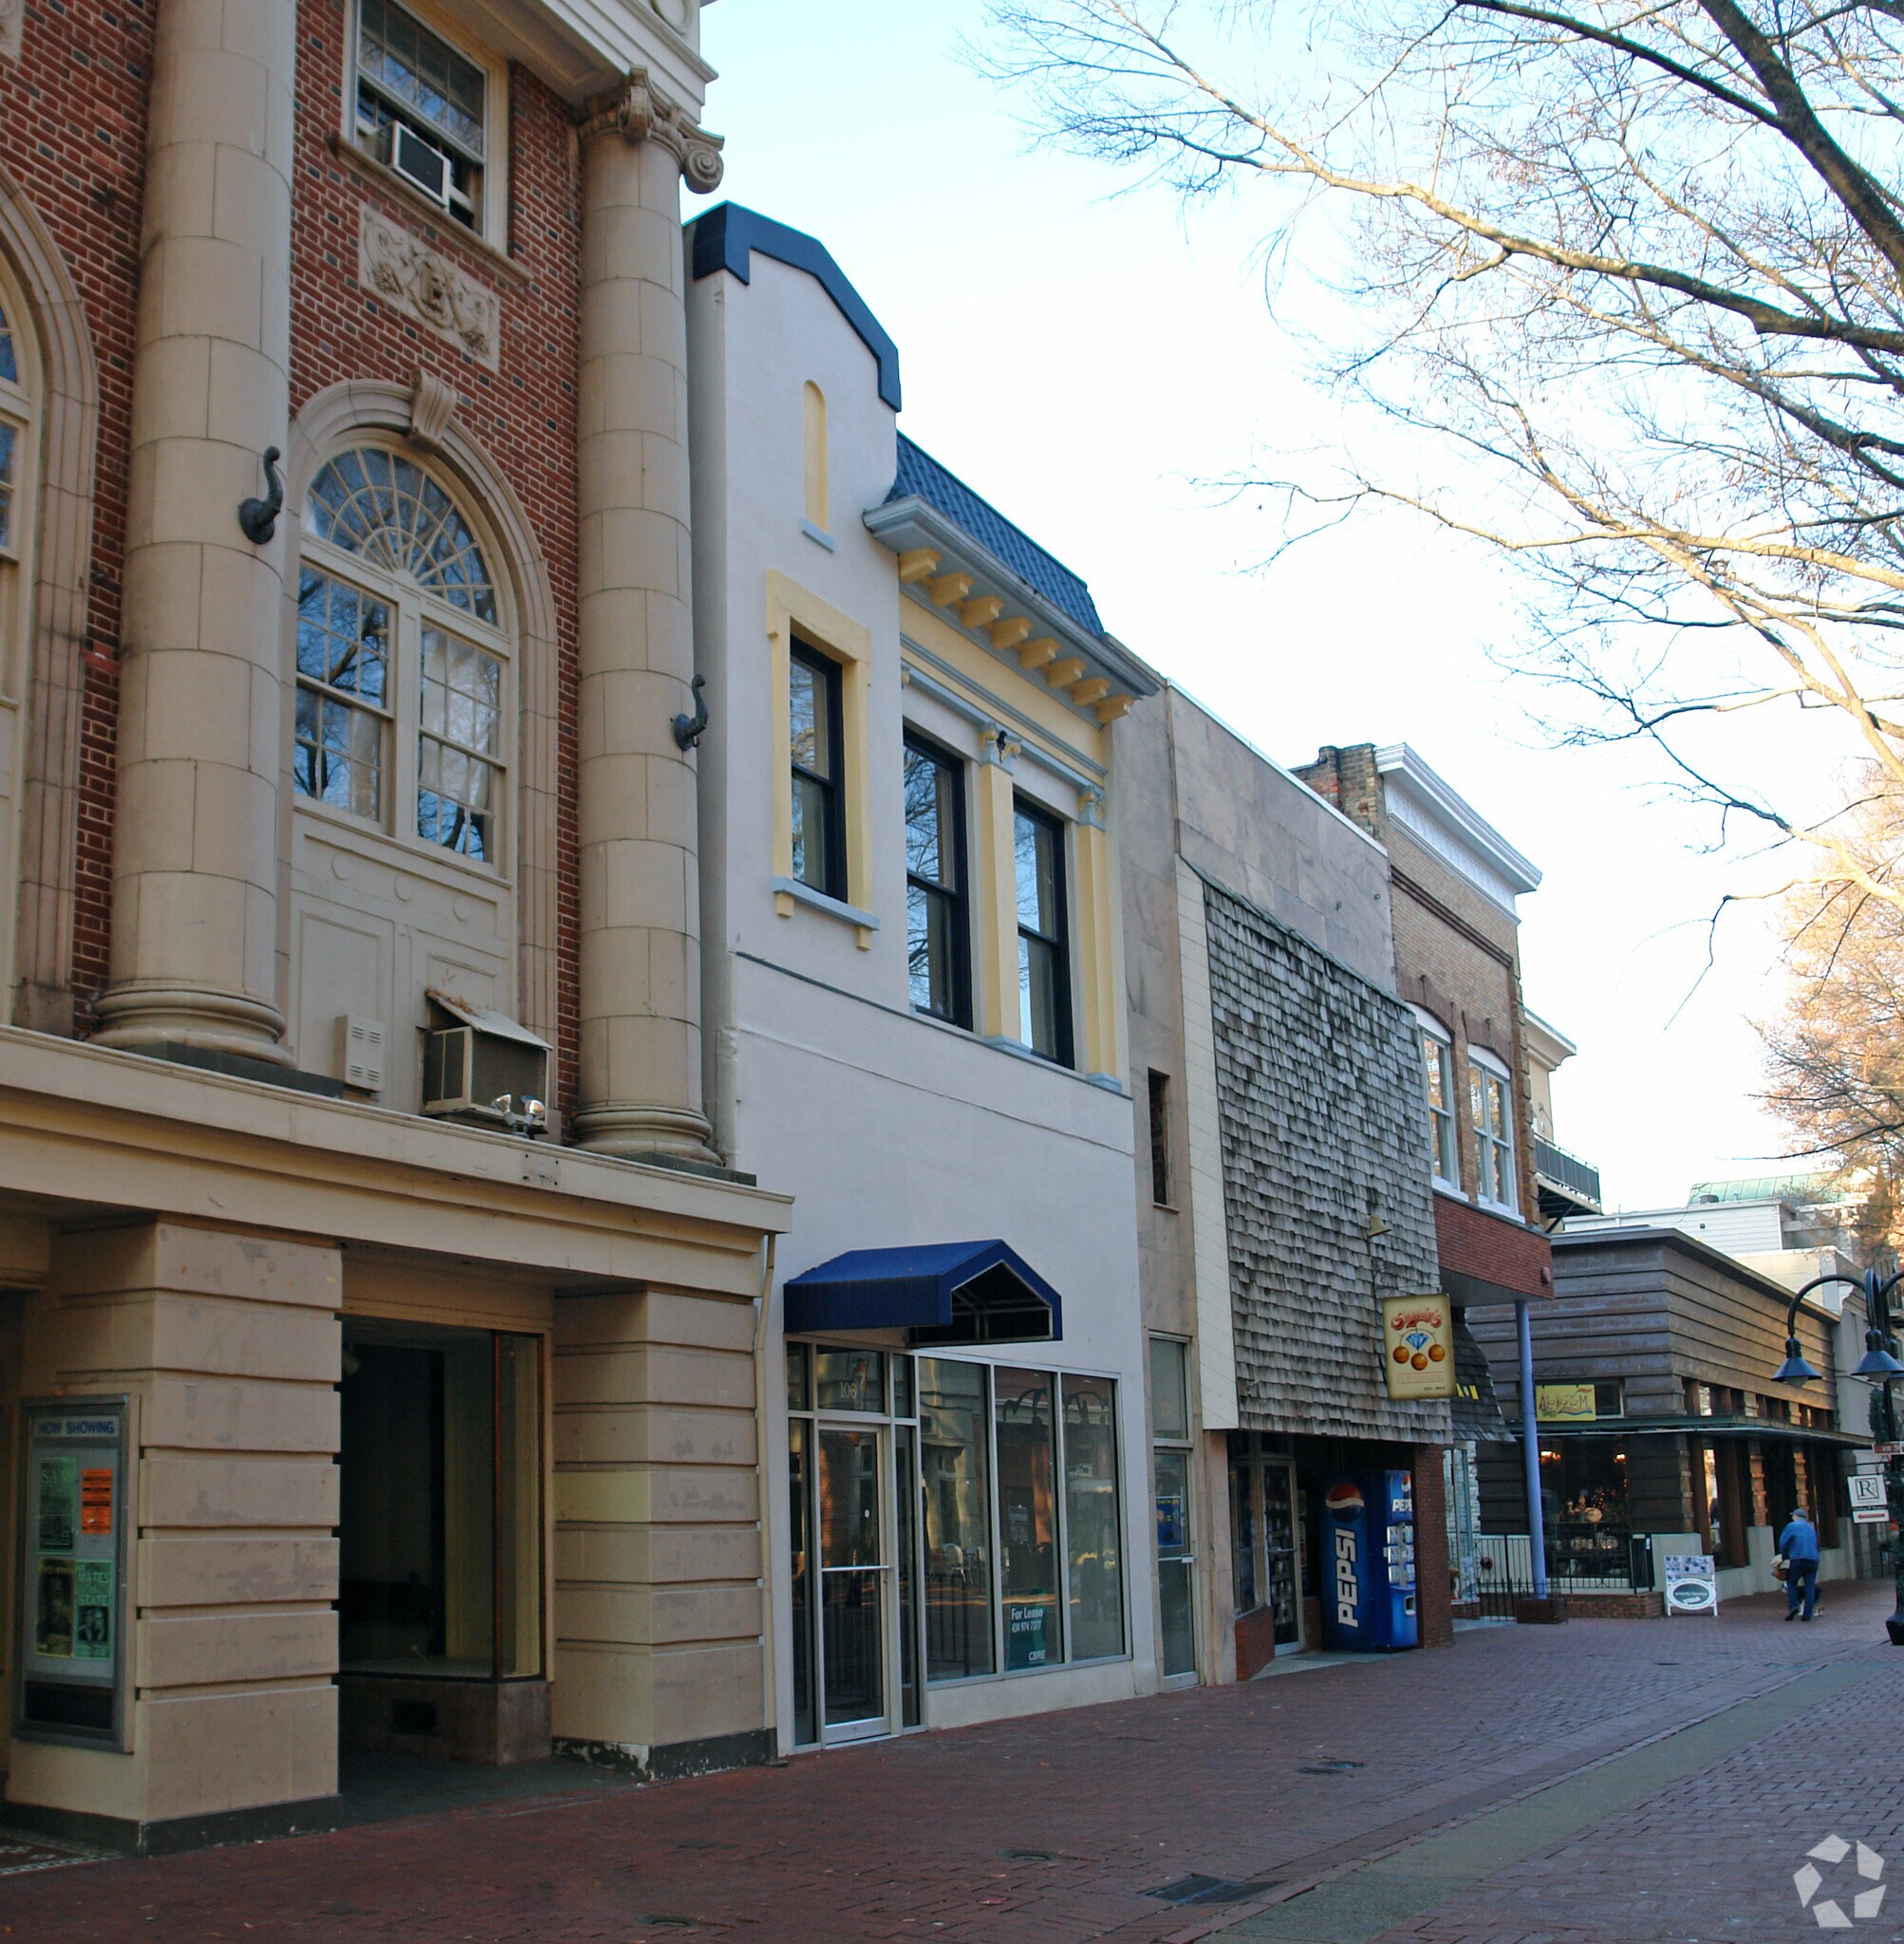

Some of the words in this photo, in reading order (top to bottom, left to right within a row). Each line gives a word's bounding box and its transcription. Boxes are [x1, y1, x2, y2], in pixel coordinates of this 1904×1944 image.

[39, 1421, 61, 1434] NOW
[65, 1420, 115, 1434] SHOWING
[1392, 1498, 1412, 1512] PEP
[1335, 1527, 1359, 1628] PEPSI
[79, 1596, 108, 1606] STATE
[1011, 1608, 1023, 1620] For
[1023, 1607, 1043, 1618] Lease
